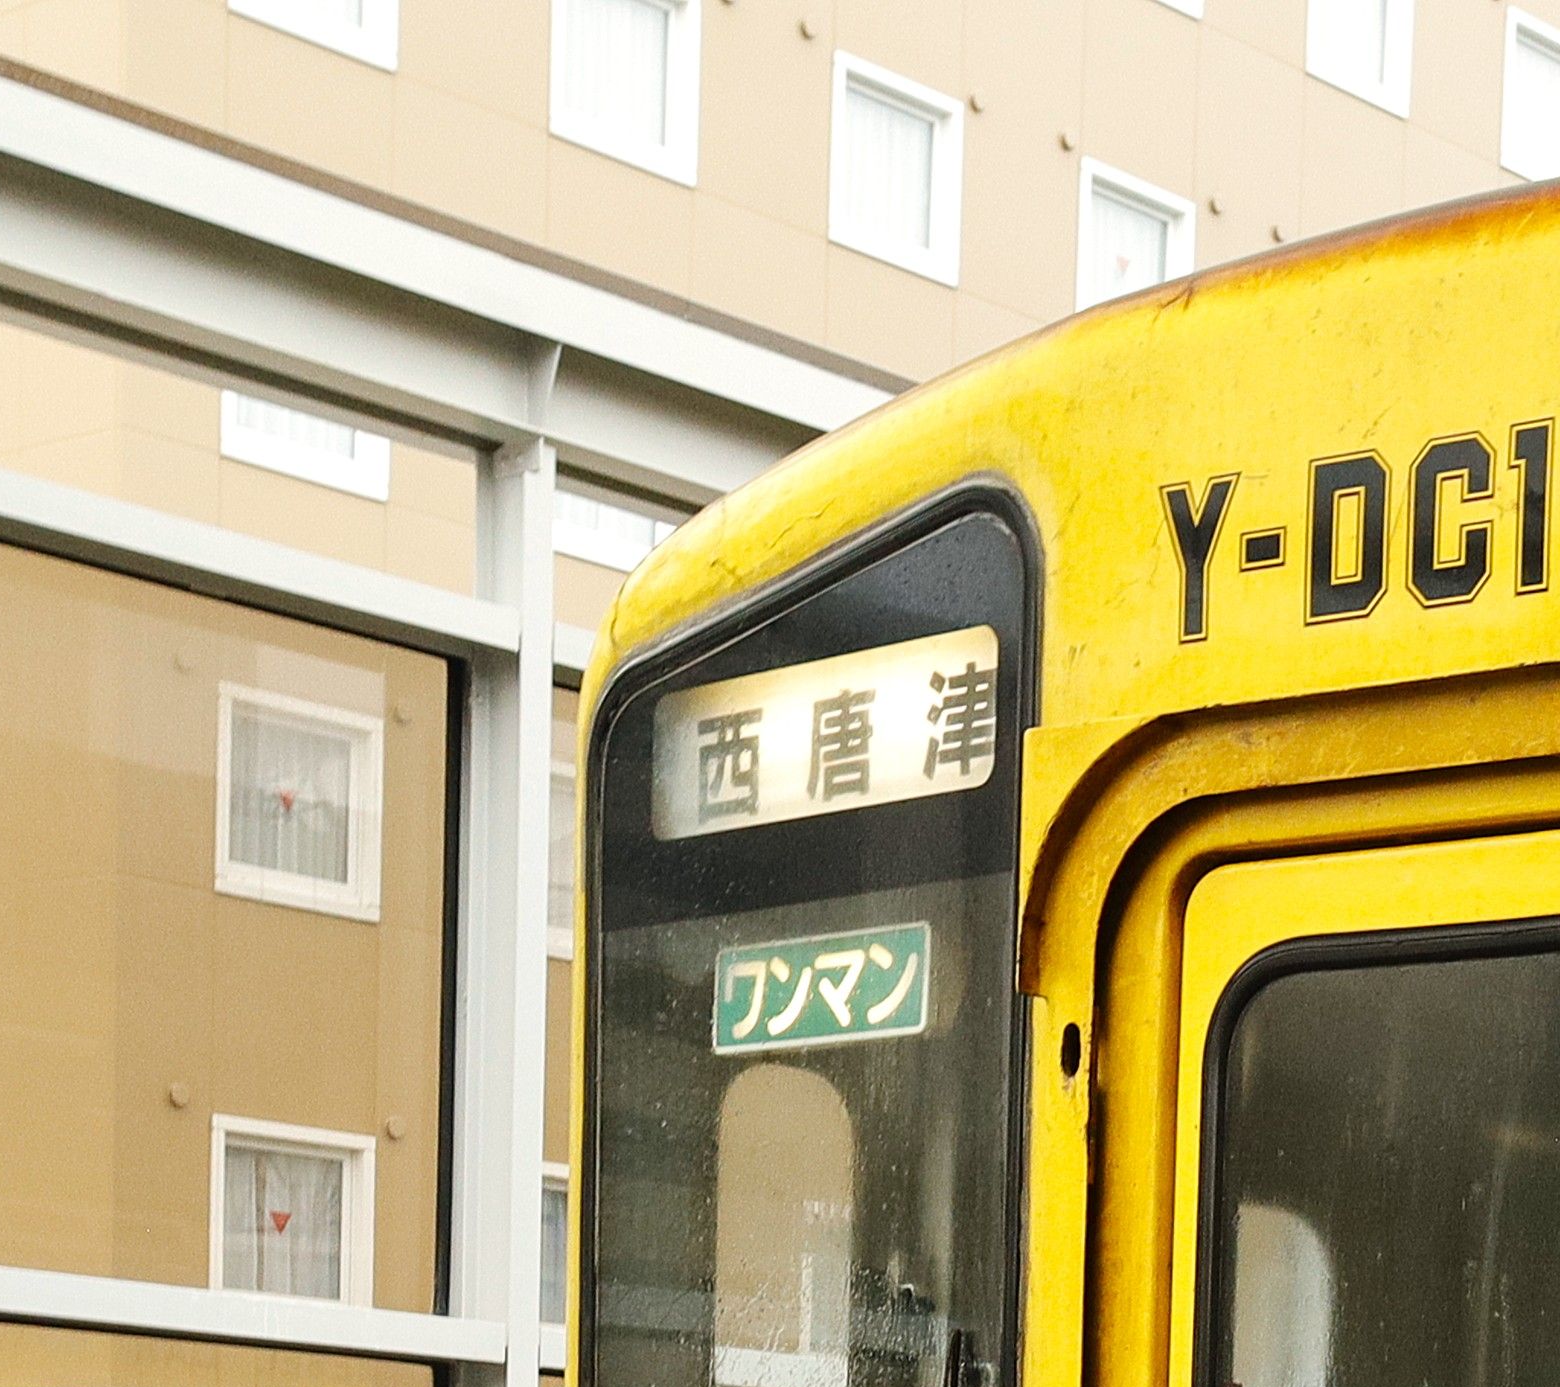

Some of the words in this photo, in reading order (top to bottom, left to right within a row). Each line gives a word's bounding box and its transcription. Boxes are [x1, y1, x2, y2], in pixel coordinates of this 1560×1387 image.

[697, 662, 998, 825] 西唐津
[723, 943, 919, 1039] ワンマン
